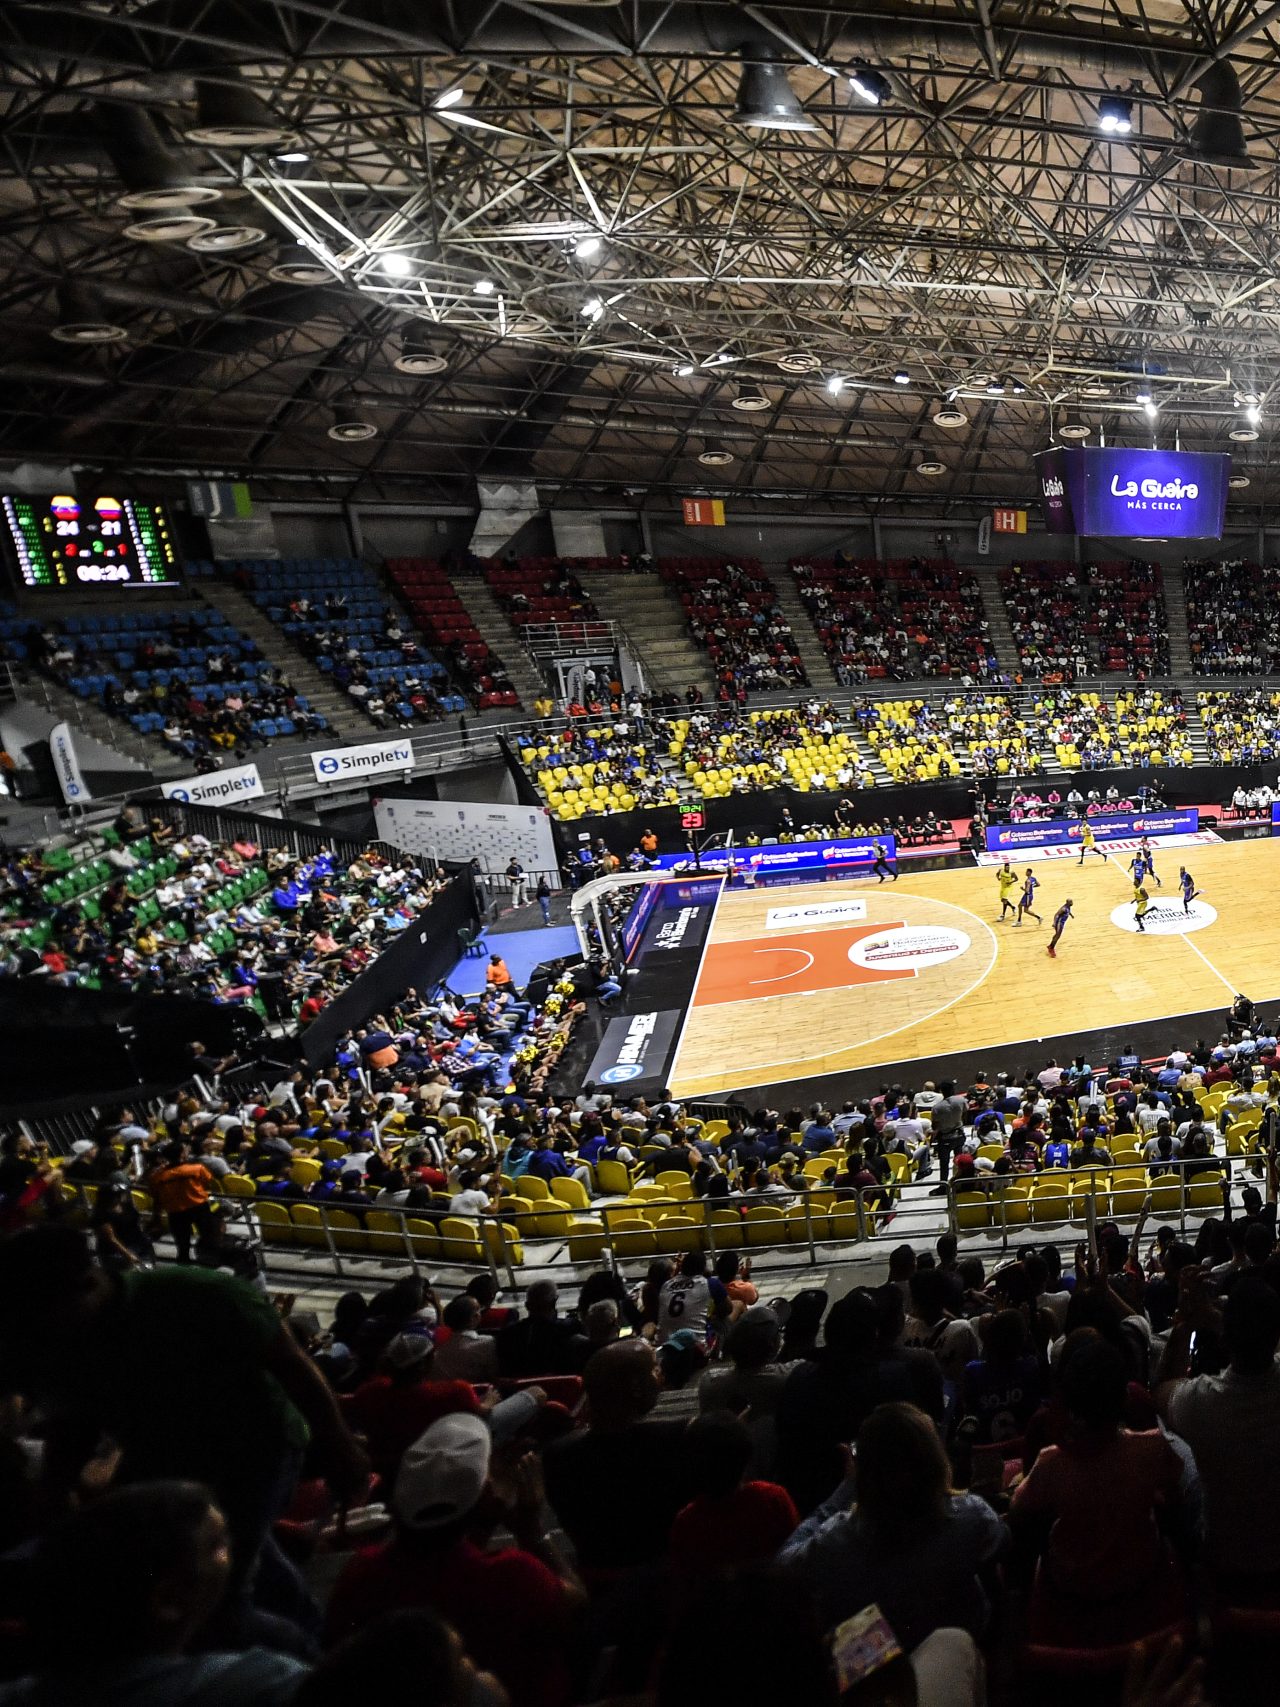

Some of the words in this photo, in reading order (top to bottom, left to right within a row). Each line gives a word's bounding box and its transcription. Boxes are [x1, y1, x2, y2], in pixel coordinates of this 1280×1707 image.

[1111, 474, 1139, 497] La
[1141, 477, 1199, 500] Guaira
[208, 481, 222, 518] J
[1127, 500, 1147, 510] MÁS
[1151, 501, 1182, 511] CERCA
[694, 502, 701, 522] I
[1002, 511, 1015, 530] H
[56, 520, 80, 536] 24
[101, 520, 122, 536] 21
[341, 748, 409, 770] Simpletv
[191, 774, 257, 801] Simpletv
[683, 812, 702, 828] 23
[1043, 847, 1072, 856] LA
[804, 905, 861, 916] Guaira
[668, 1291, 686, 1318] 6
